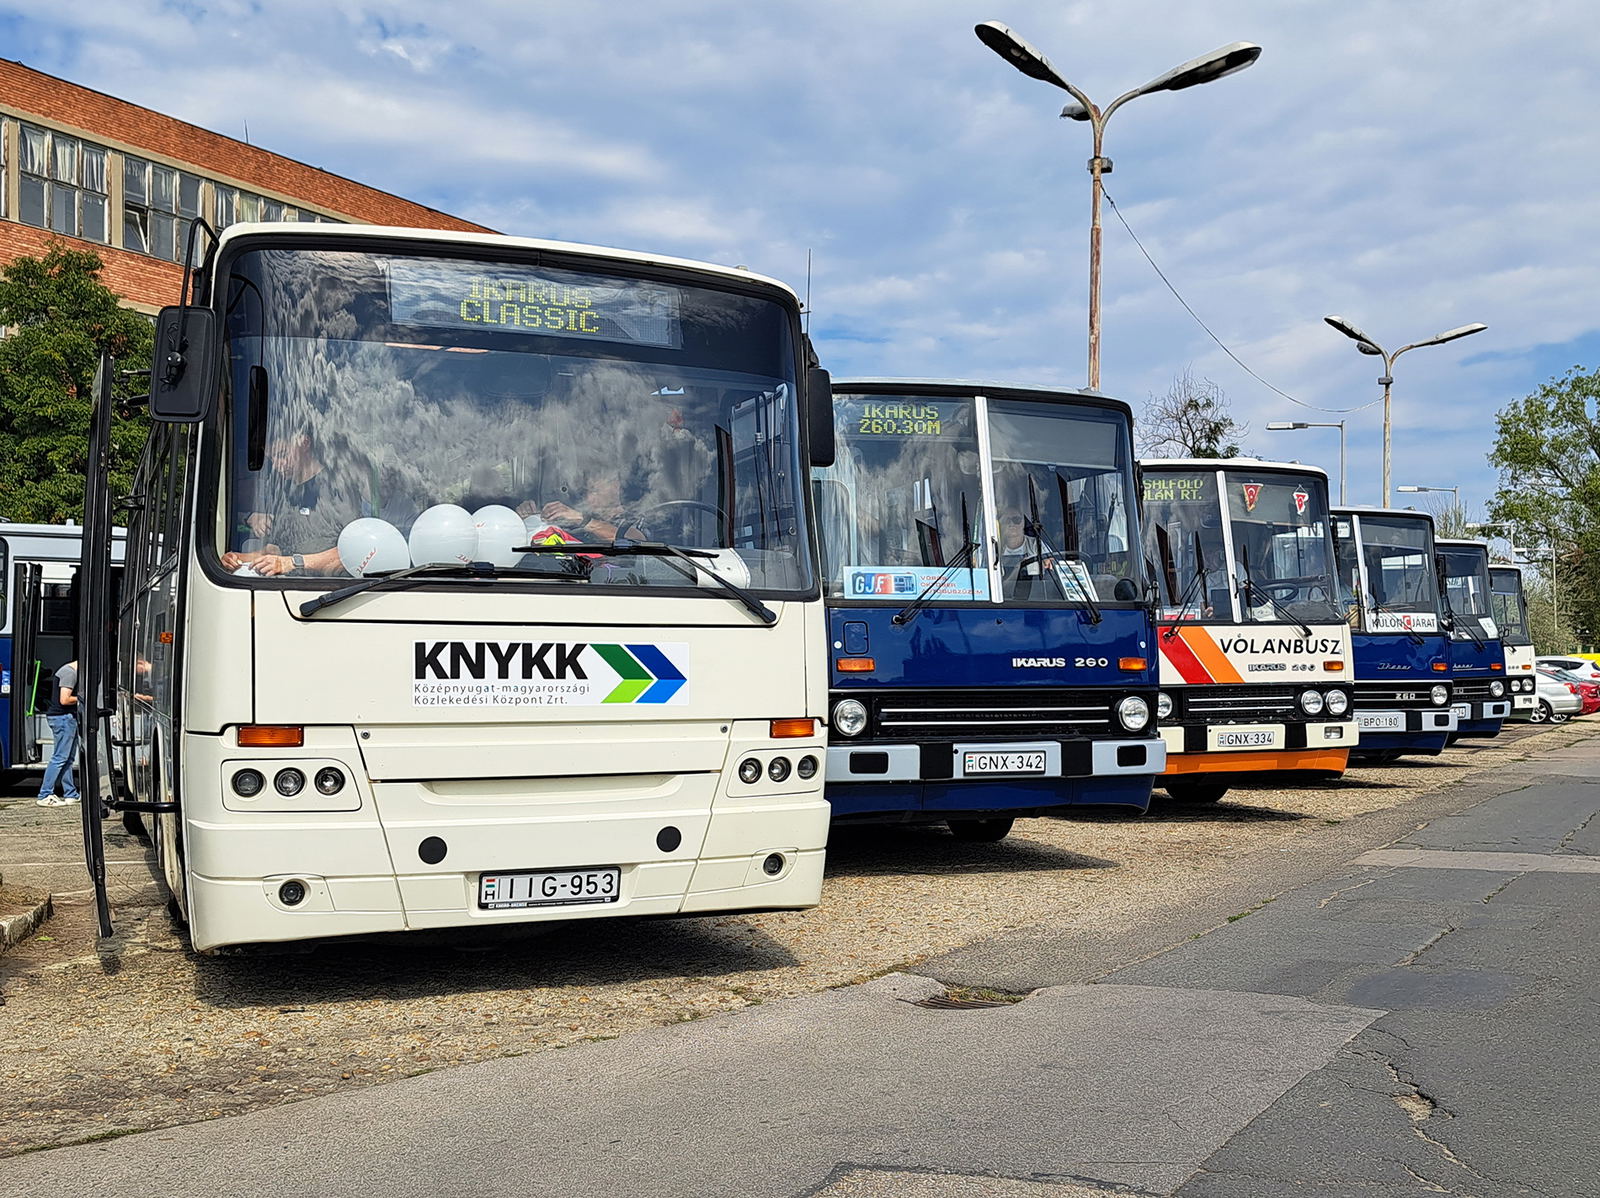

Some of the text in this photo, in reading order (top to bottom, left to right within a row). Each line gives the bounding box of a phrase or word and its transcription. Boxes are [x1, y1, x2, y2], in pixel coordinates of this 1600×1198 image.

[469, 276, 592, 309] IKARUS
[459, 298, 600, 333] CLASSIC
[862, 403, 939, 420] IKARUS
[859, 419, 941, 435] 260.30M
[1180, 489, 1203, 501] RT.
[415, 641, 588, 680] KNYKK
[1012, 657, 1108, 667] IKARUS 260
[1248, 663, 1287, 673] IKARUS
[414, 683, 590, 695] Középnyugat-magyarországi
[414, 694, 568, 706] Közlekedési Központ Zrt.
[1227, 733, 1272, 745] GNX-334
[978, 755, 1043, 770] GNX-342
[485, 890, 496, 900] H
